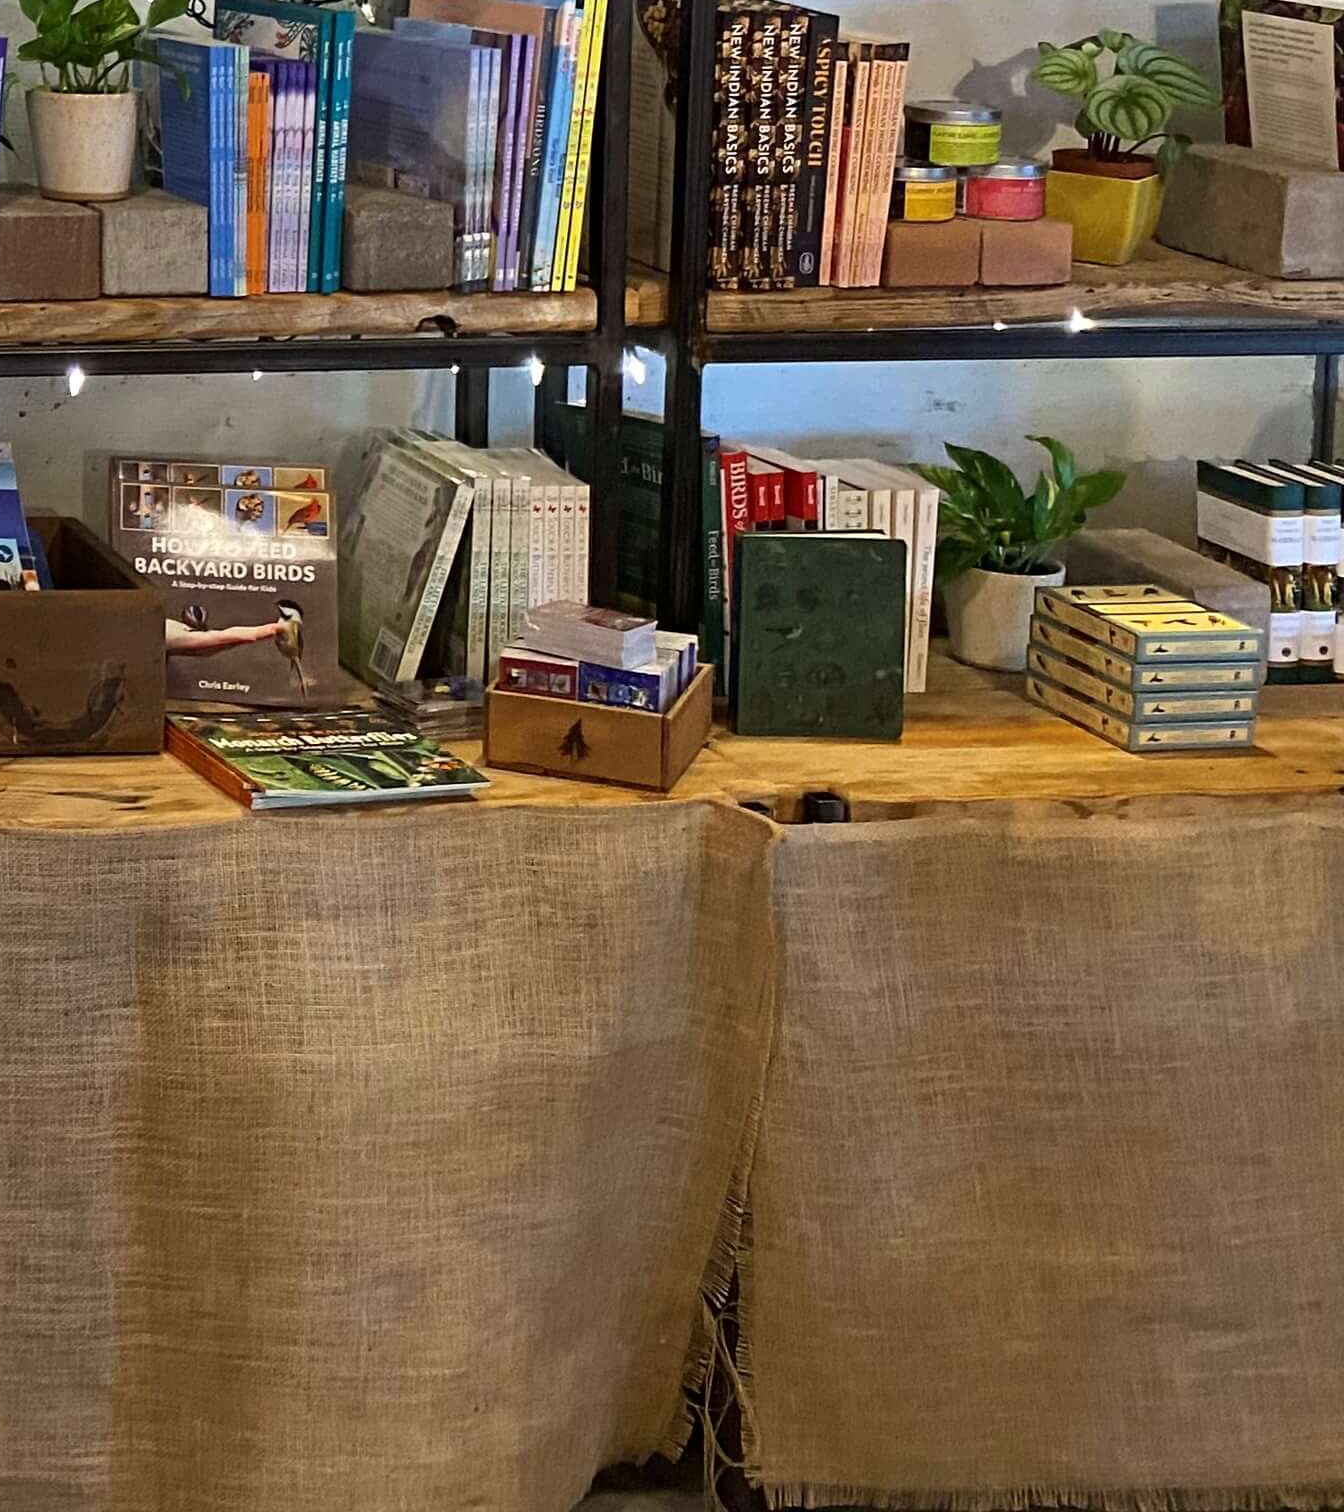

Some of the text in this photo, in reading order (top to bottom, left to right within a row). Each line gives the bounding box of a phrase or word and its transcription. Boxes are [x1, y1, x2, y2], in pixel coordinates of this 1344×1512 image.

[725, 24, 744, 175] NEW INDIAN BASICS
[808, 48, 831, 166] SPICY TOUCH
[530, 104, 546, 177] BIRDSONG
[729, 461, 748, 521] BIRDS
[134, 558, 316, 582] BACKYARD BIRDS
[198, 681, 221, 690] Chris
[210, 732, 417, 750] Monarch Butterflies
